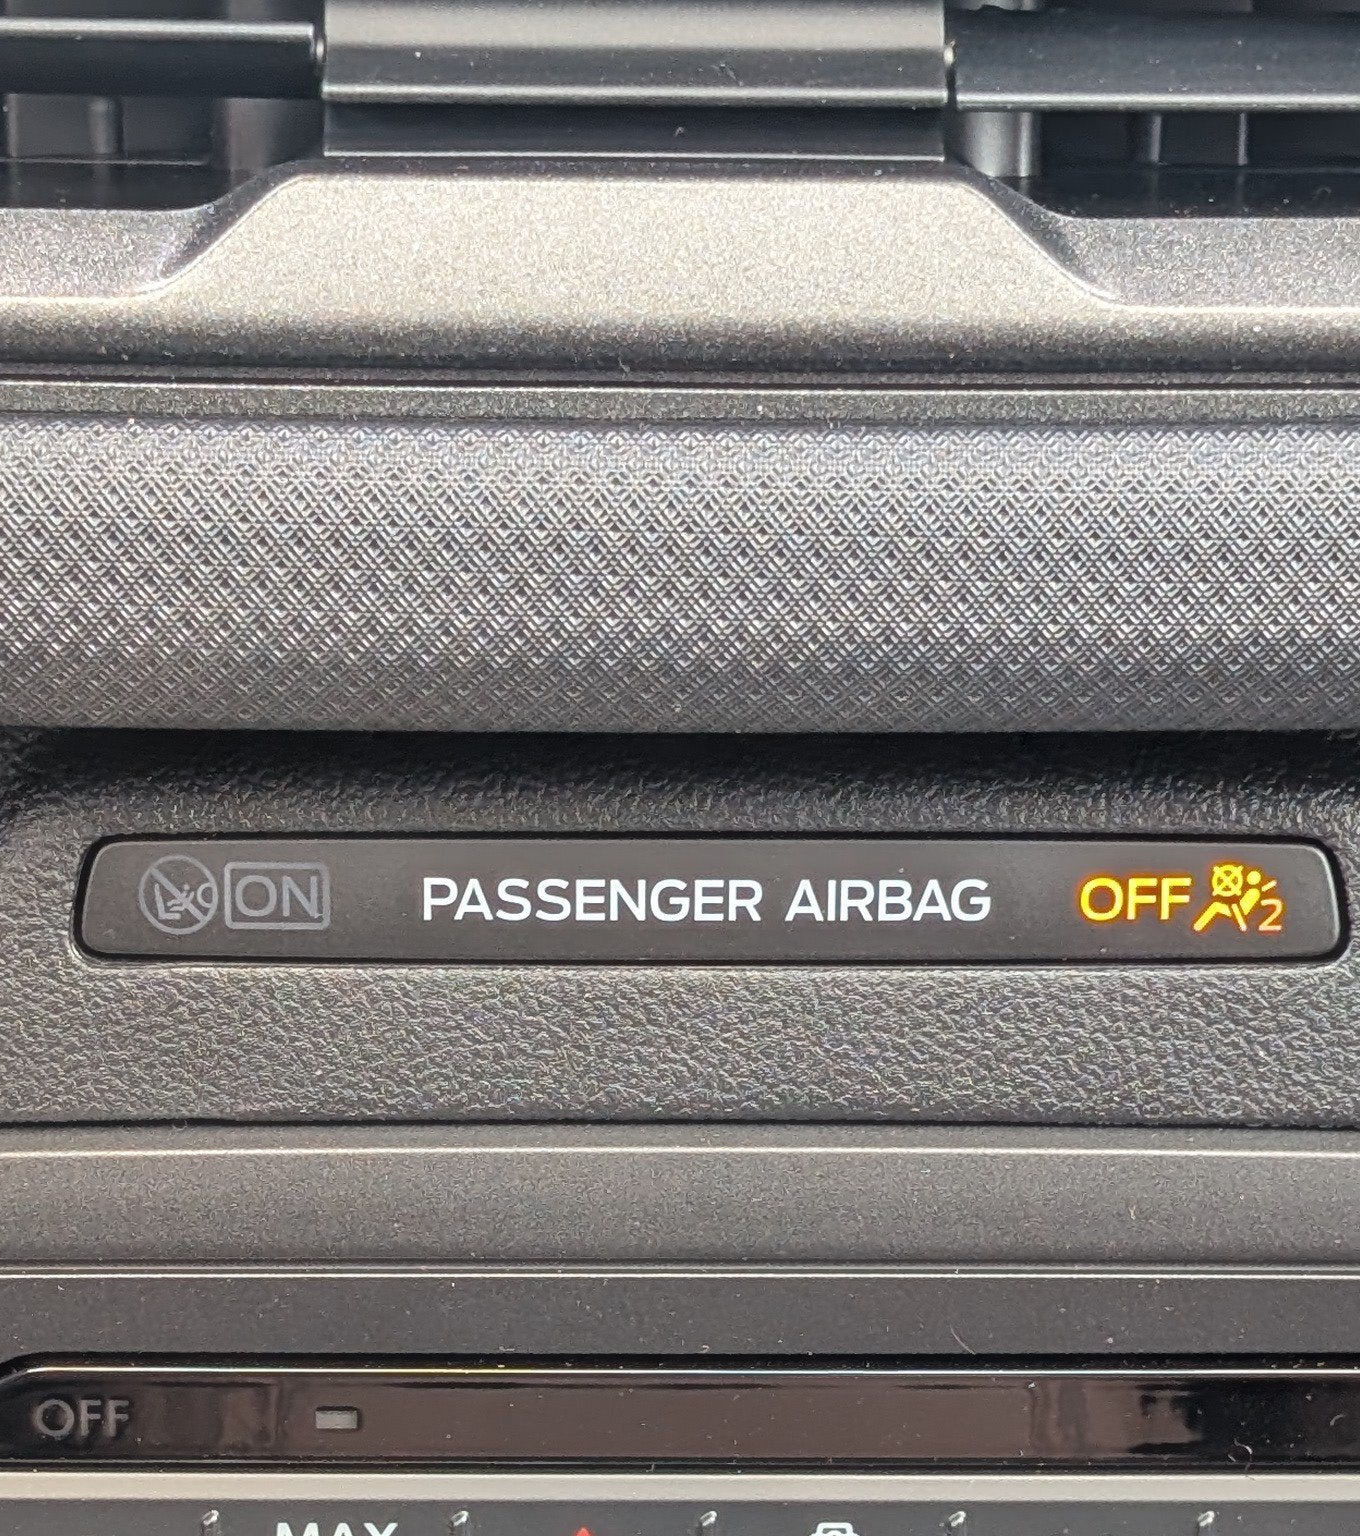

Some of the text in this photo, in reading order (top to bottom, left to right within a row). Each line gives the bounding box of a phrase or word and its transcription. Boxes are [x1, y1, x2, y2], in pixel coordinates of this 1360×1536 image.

[235, 874, 319, 918] ON
[423, 876, 992, 923] PASSENGER AIRBAG
[1079, 876, 1192, 921] OFF
[1258, 898, 1284, 932] 2
[34, 1398, 130, 1440] OFF
